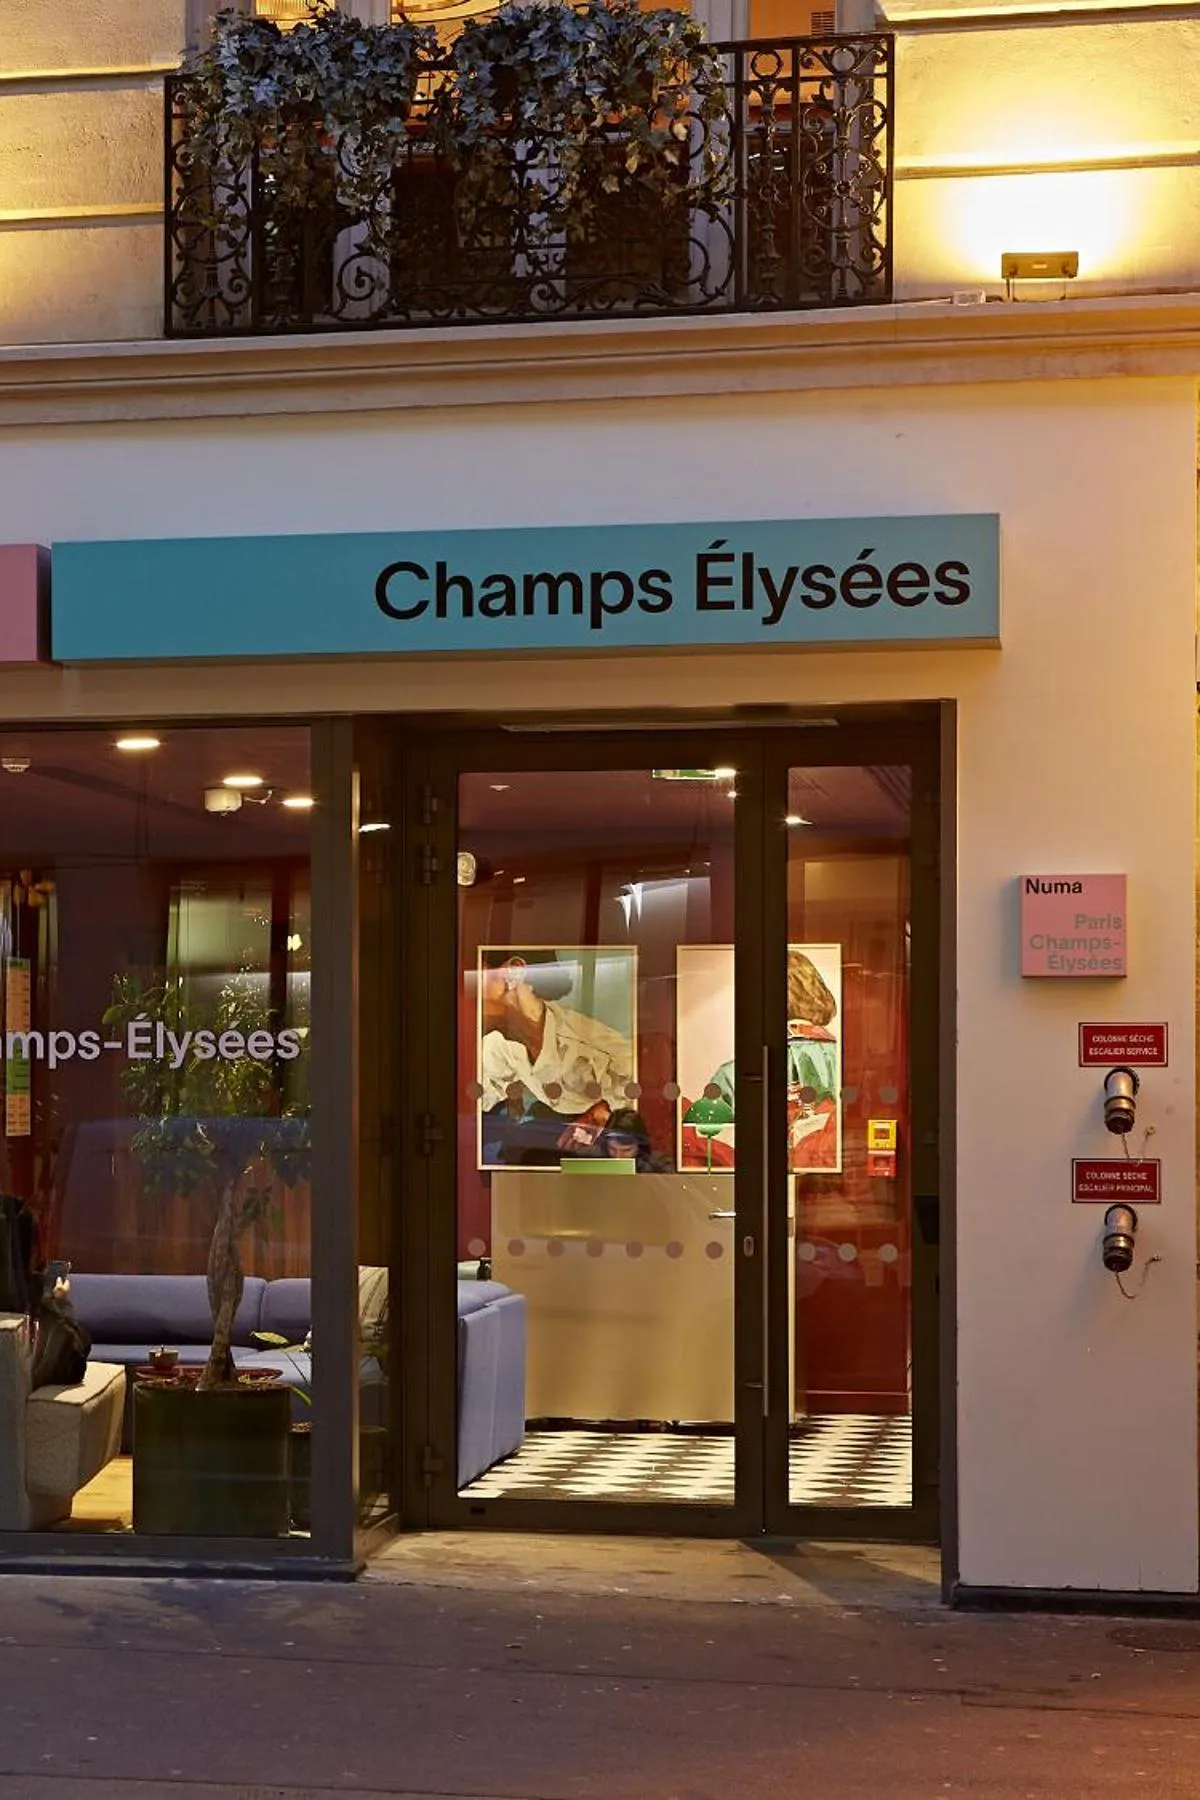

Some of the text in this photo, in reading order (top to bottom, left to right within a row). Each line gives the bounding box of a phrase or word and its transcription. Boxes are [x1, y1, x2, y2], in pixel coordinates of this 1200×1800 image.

[374, 540, 971, 629] Champs Élysées
[1026, 878, 1083, 894] Numa
[1074, 913, 1123, 930] Paris
[1029, 934, 1121, 952] Champs-
[1047, 954, 1123, 973] Élysées
